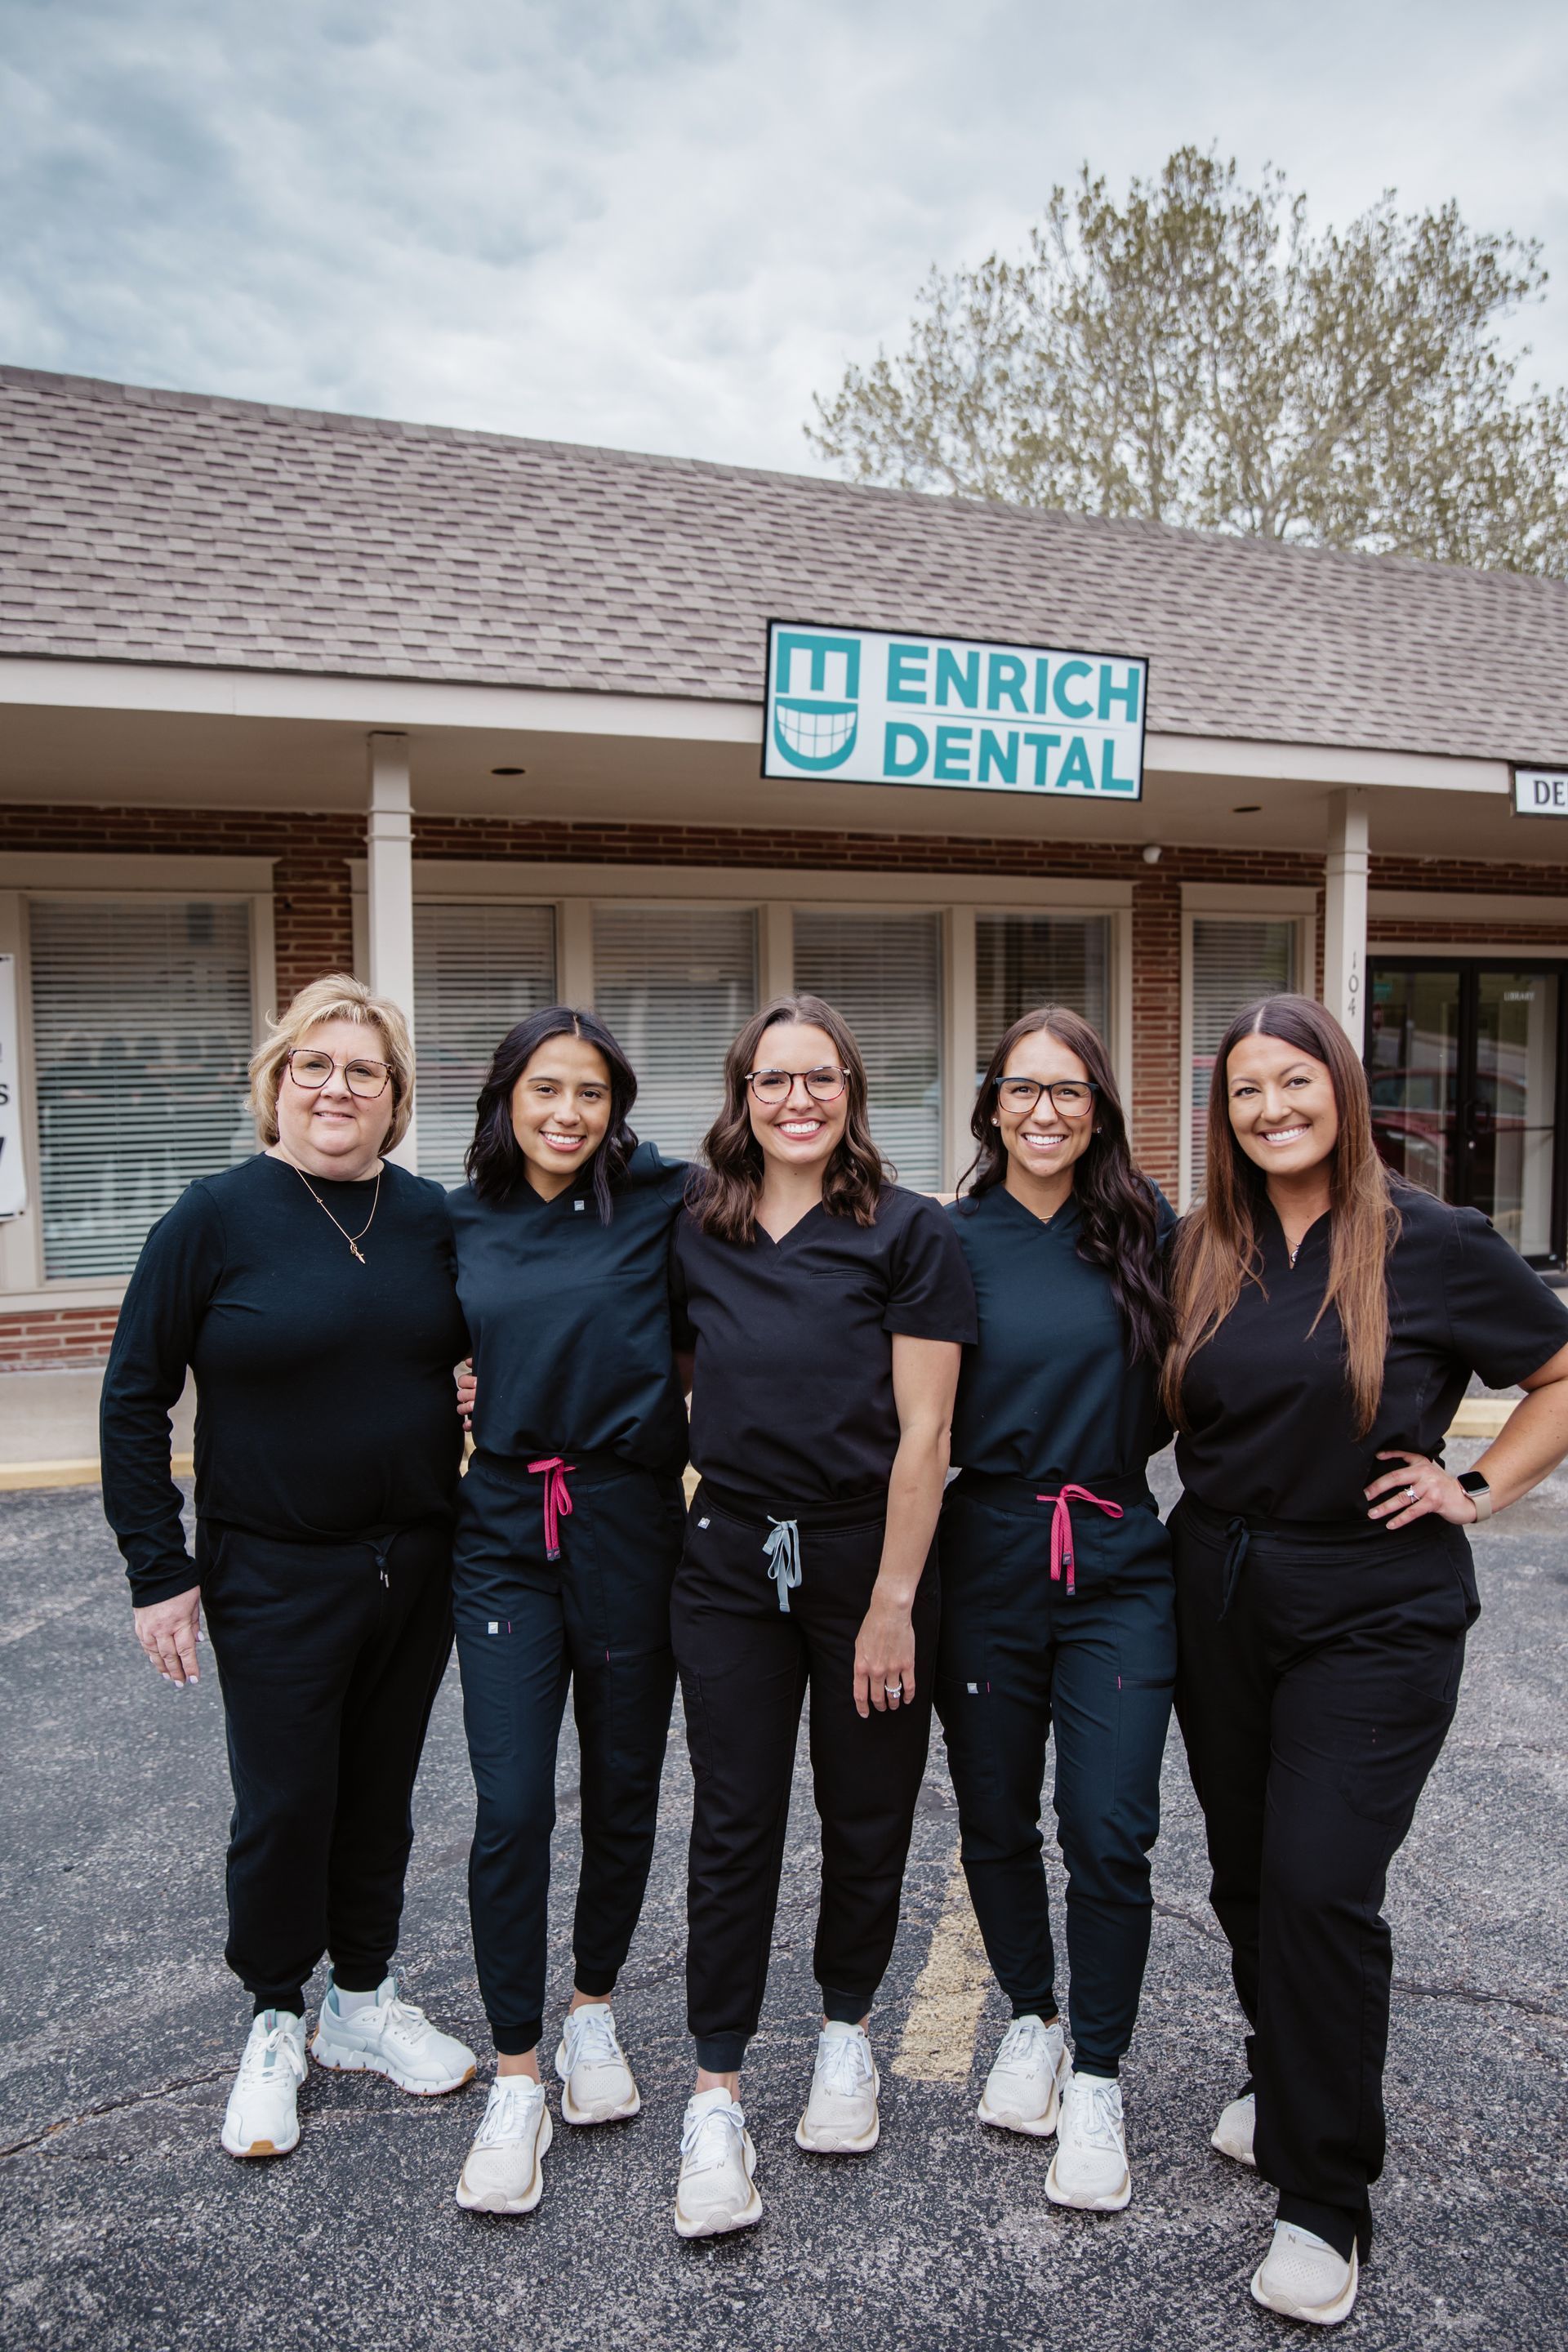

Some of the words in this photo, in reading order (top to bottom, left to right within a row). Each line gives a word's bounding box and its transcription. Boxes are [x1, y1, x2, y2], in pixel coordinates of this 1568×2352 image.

[887, 643, 1140, 724] ENRICH
[883, 721, 1134, 791] DENTAL
[1534, 780, 1568, 806] DE
[1348, 951, 1359, 1017] 104
[1503, 991, 1535, 1001] LIBRARY
[1288, 2234, 1296, 2243] N
